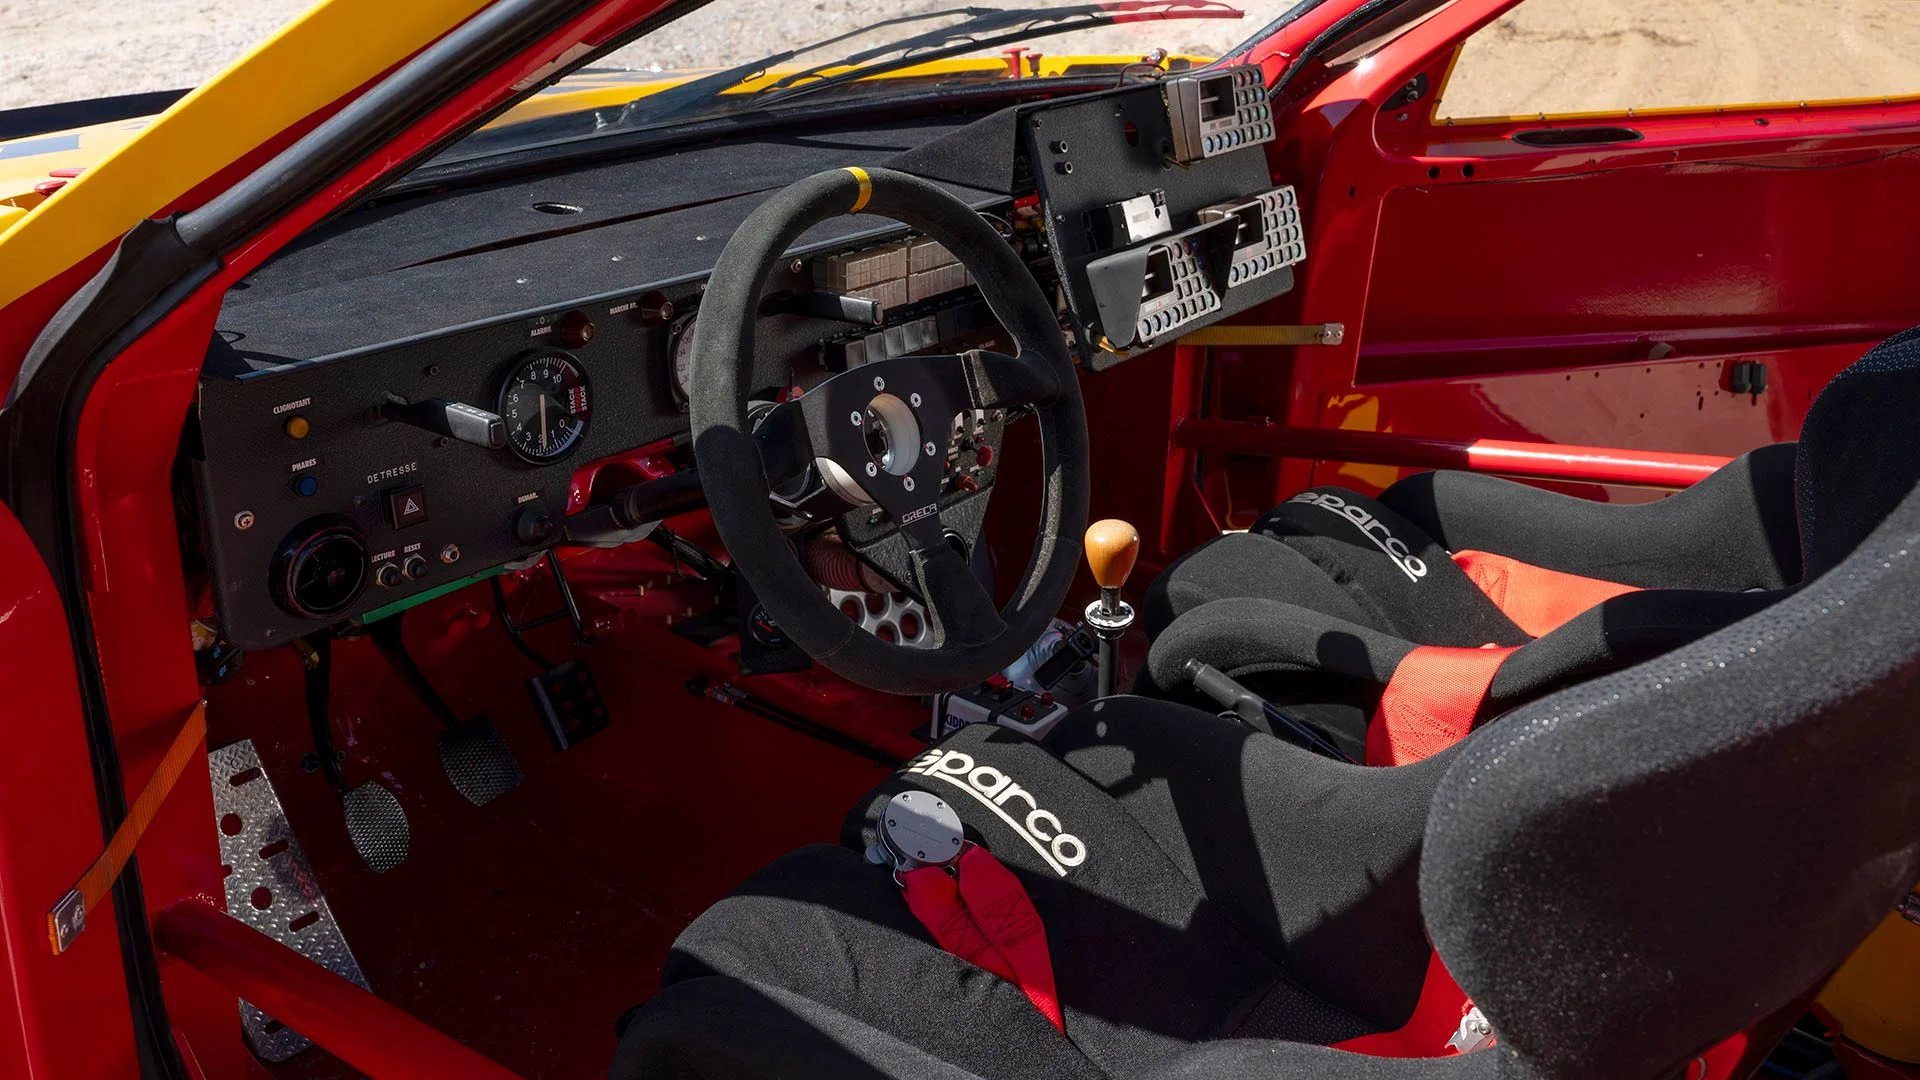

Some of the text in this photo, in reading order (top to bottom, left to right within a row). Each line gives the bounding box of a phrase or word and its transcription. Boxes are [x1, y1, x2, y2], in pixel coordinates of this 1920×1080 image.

[531, 326, 552, 337] ALARME
[530, 371, 536, 381] 8
[543, 369, 549, 379] 9
[552, 374, 562, 384] 10
[519, 380, 525, 390] 7
[512, 393, 519, 403] 6
[568, 388, 577, 414] STACK
[273, 397, 311, 415] CLIGNOTANT
[511, 408, 518, 418] 5
[516, 422, 522, 431] 4
[559, 419, 565, 428] 0
[525, 432, 532, 441] 3
[292, 458, 317, 472] PHARES
[367, 462, 417, 484] DETRESSE
[902, 503, 938, 523] ORECA
[404, 543, 421, 553] RESET
[371, 550, 396, 563] LECTURE
